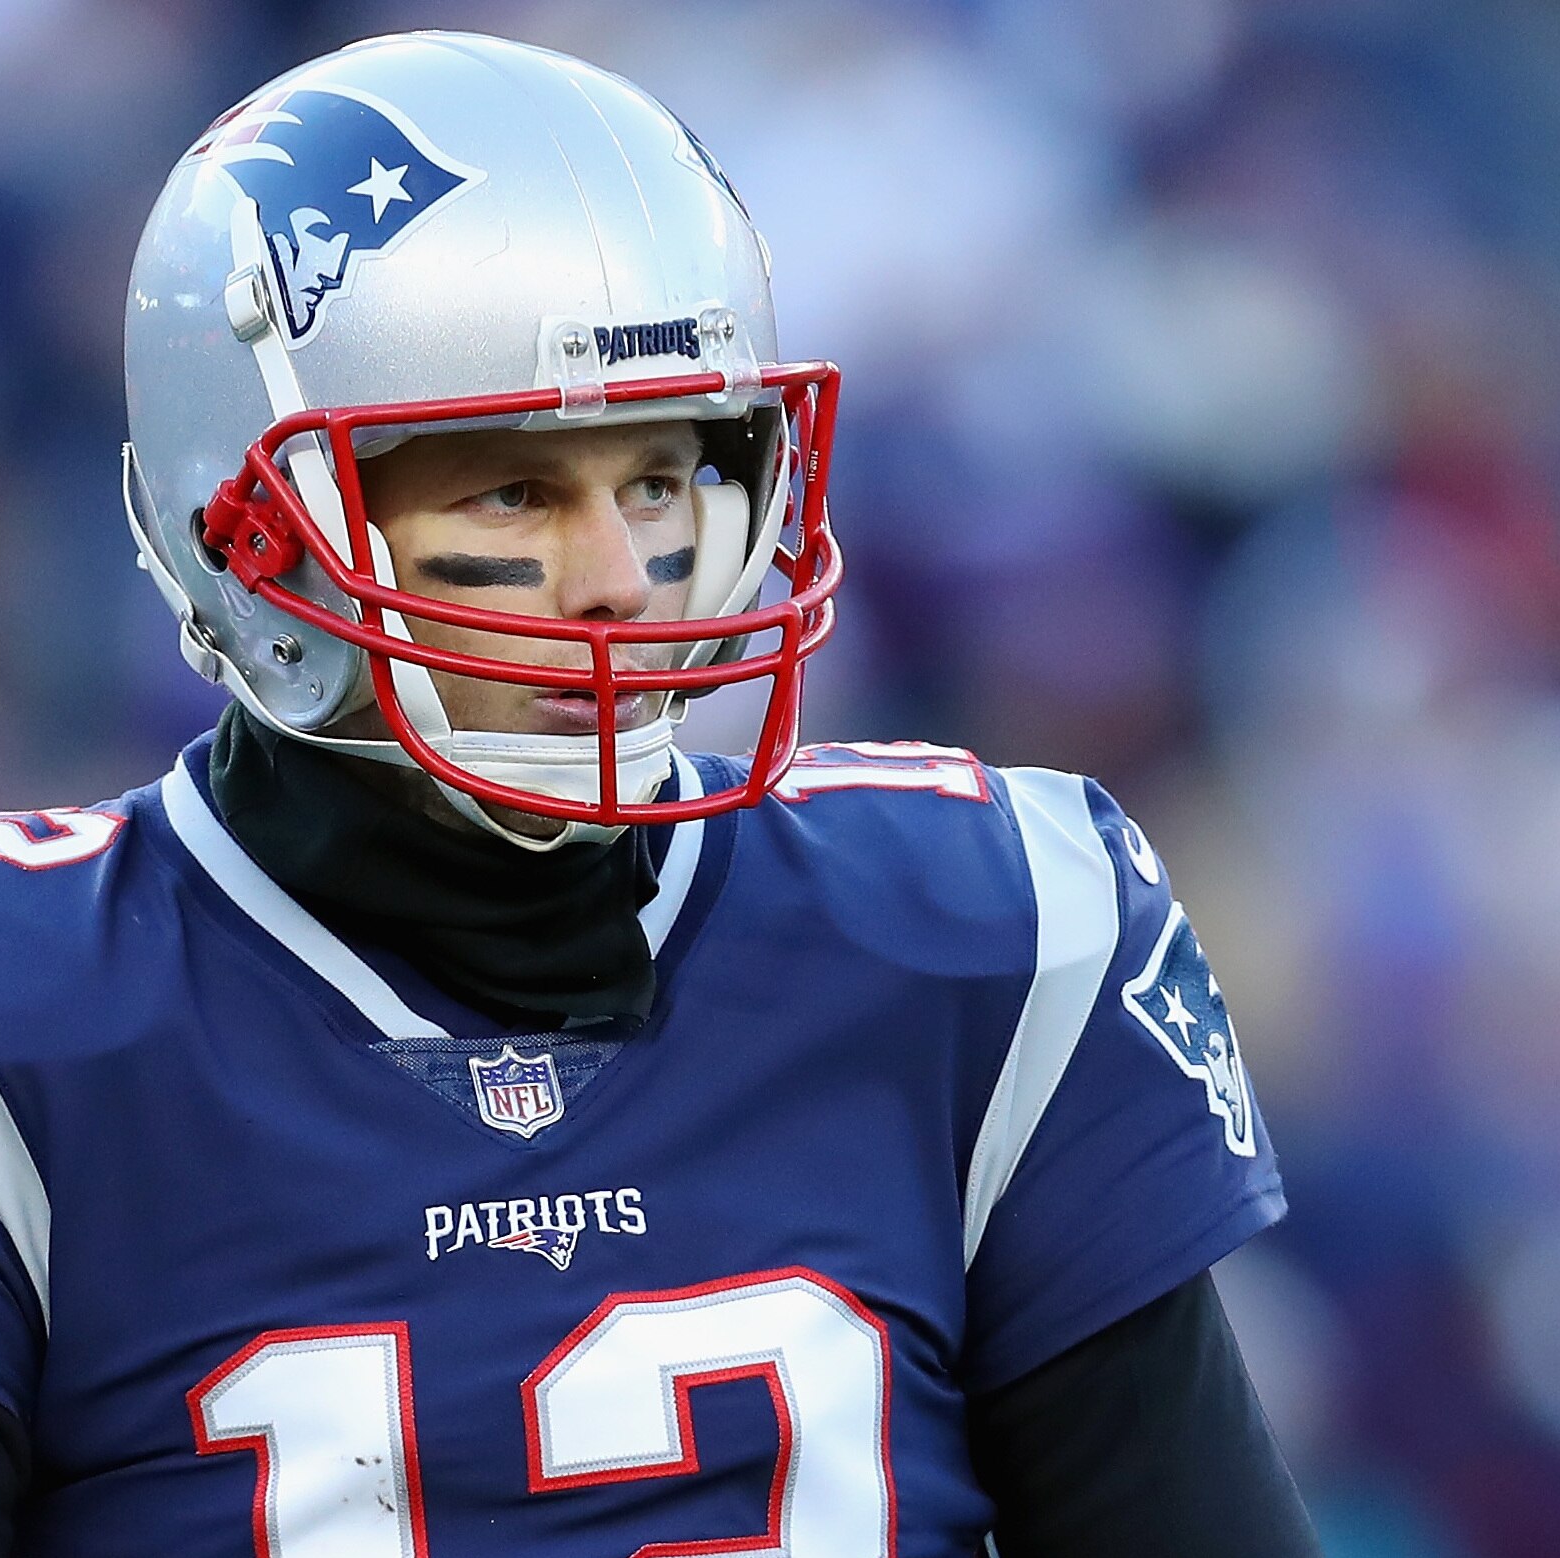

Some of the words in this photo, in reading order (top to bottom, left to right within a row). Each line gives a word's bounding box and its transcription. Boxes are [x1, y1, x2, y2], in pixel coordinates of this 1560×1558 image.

[593, 316, 701, 366] PATRIOTS
[490, 1084, 551, 1118] NFL
[424, 1187, 647, 1261] PATRIOTS
